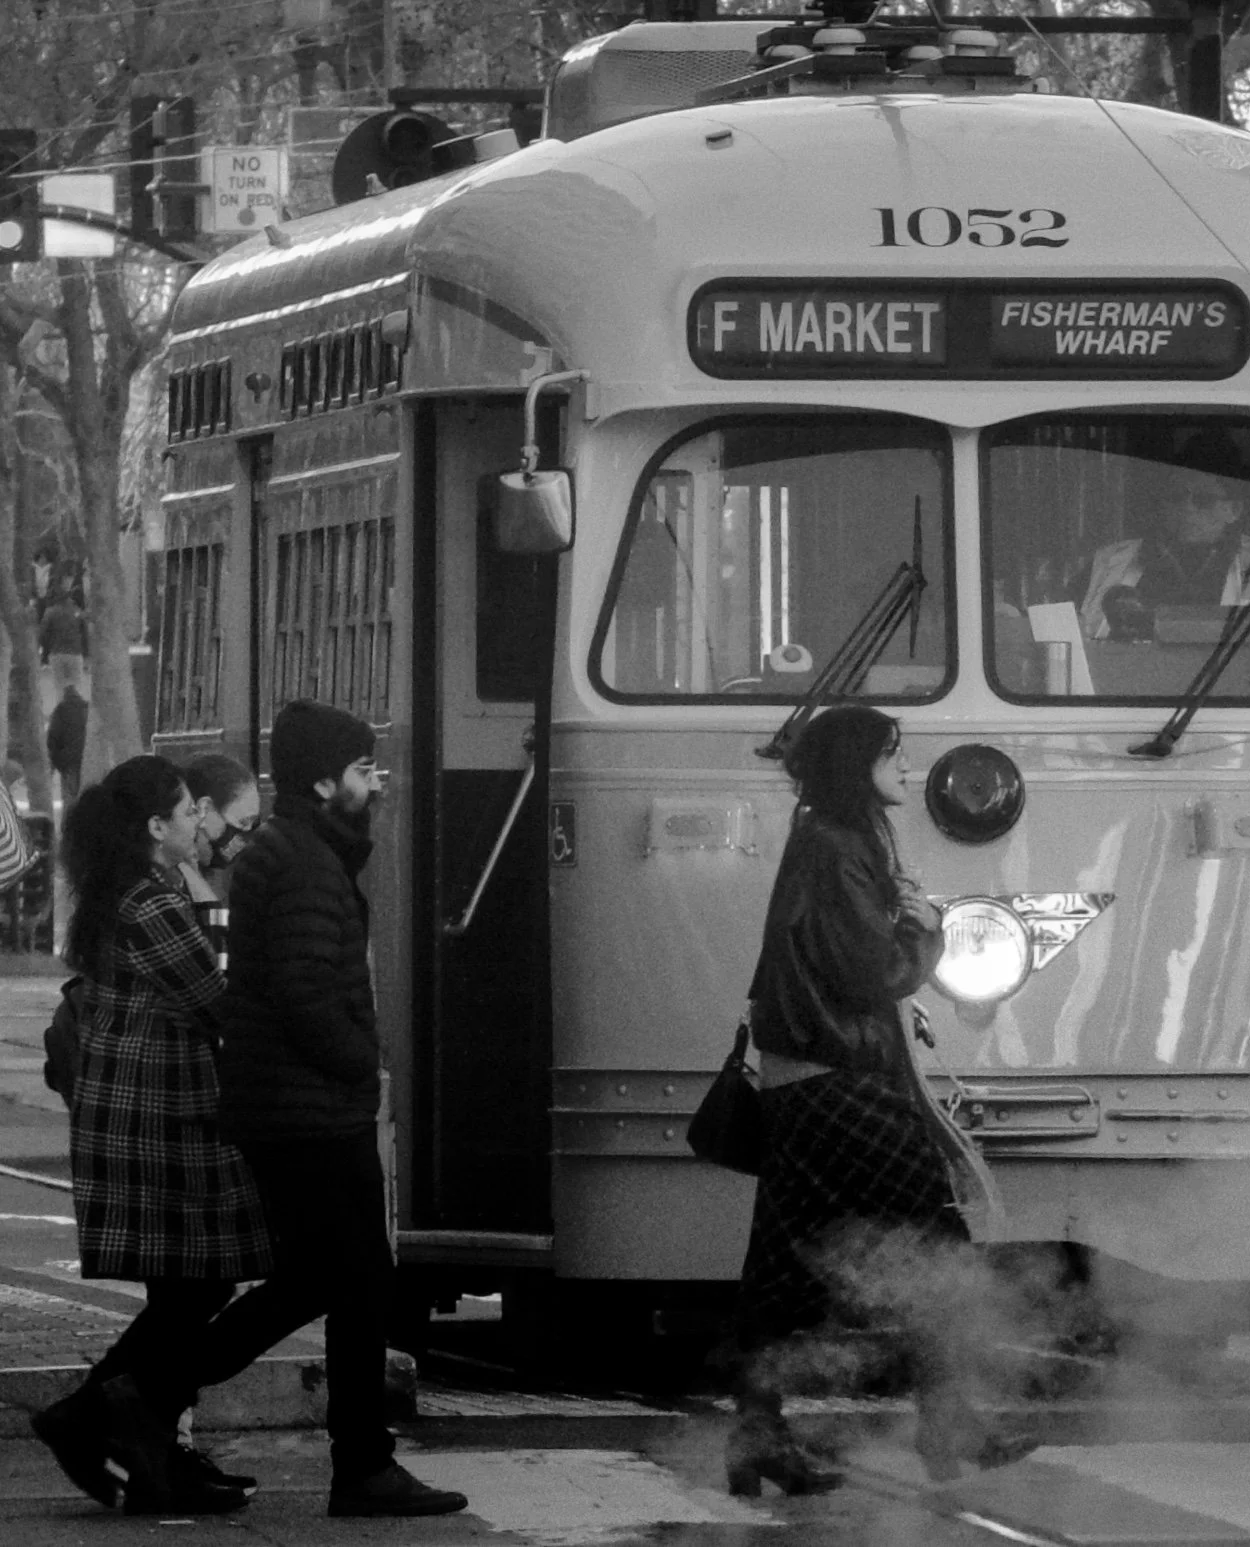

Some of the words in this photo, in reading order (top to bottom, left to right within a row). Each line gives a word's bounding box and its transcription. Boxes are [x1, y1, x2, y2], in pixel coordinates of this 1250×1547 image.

[231, 156, 261, 172] NO
[228, 176, 266, 189] TURN
[220, 194, 239, 206] ON
[247, 193, 274, 206] RED
[870, 206, 1070, 248] 1052
[714, 301, 739, 352] F
[759, 301, 941, 353] MARKET
[1001, 301, 1227, 328] FISHERMAN'S
[1055, 330, 1173, 355] WHARF
